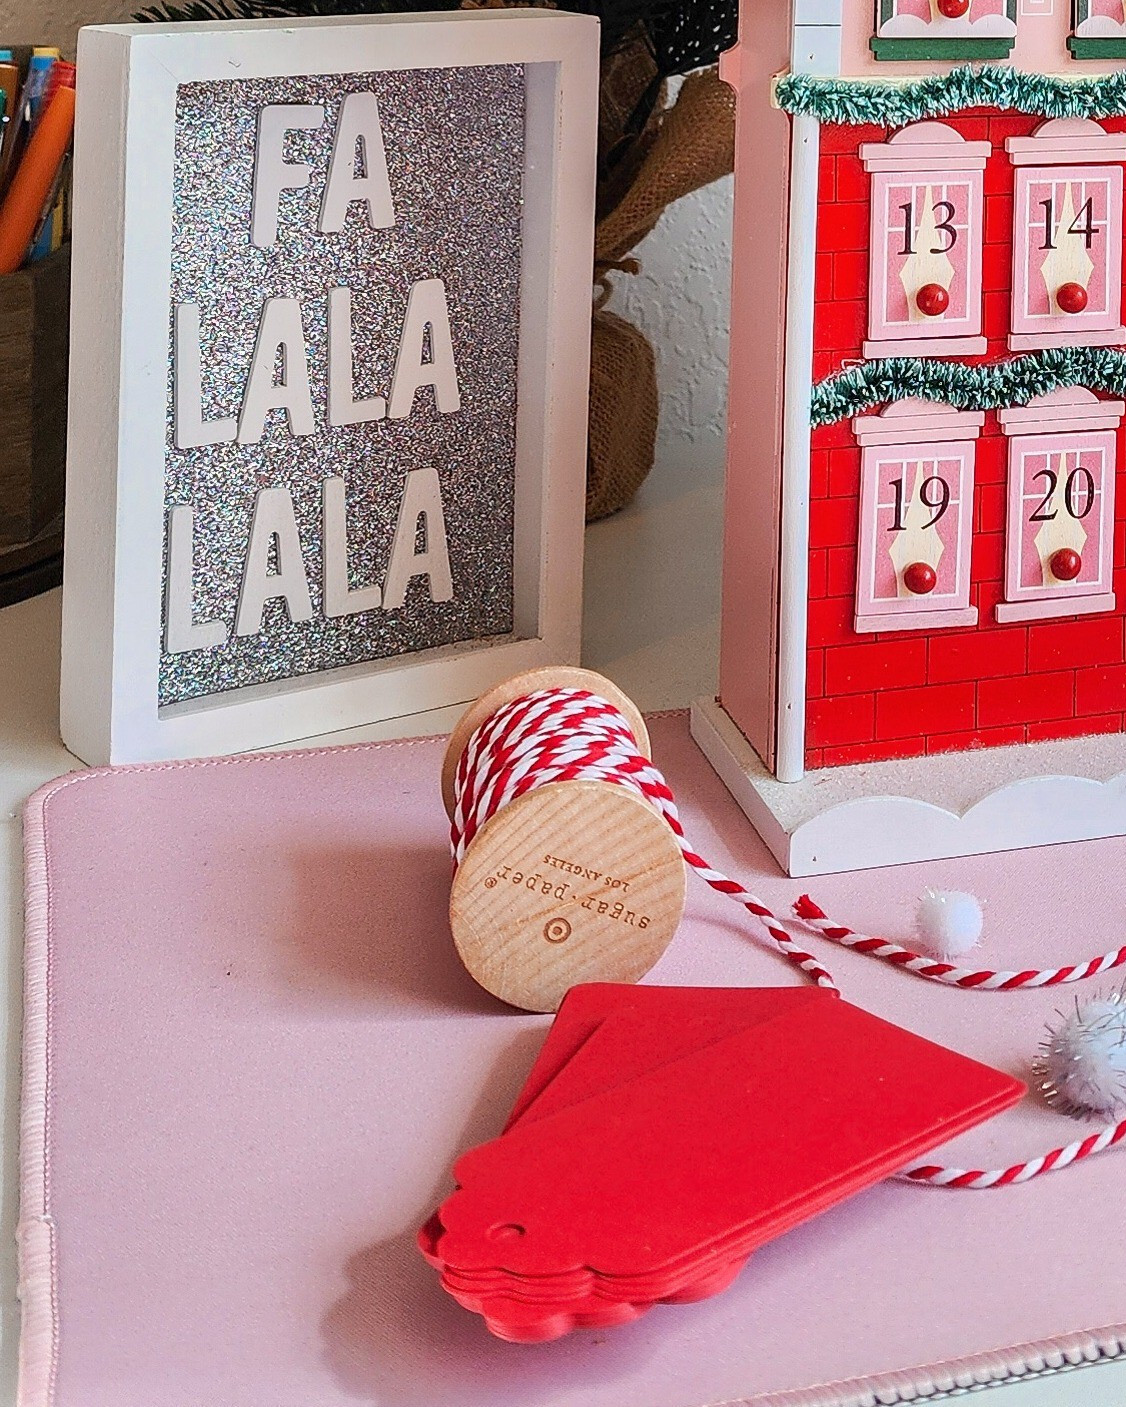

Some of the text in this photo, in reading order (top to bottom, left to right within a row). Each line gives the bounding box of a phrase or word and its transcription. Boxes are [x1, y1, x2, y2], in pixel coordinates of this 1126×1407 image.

[251, 92, 395, 248] FA
[897, 201, 958, 256] 13
[1037, 197, 1100, 251] 14
[886, 475, 950, 532] 19
[1029, 467, 1095, 522] 20
[542, 854, 630, 893] LOS ANGELES
